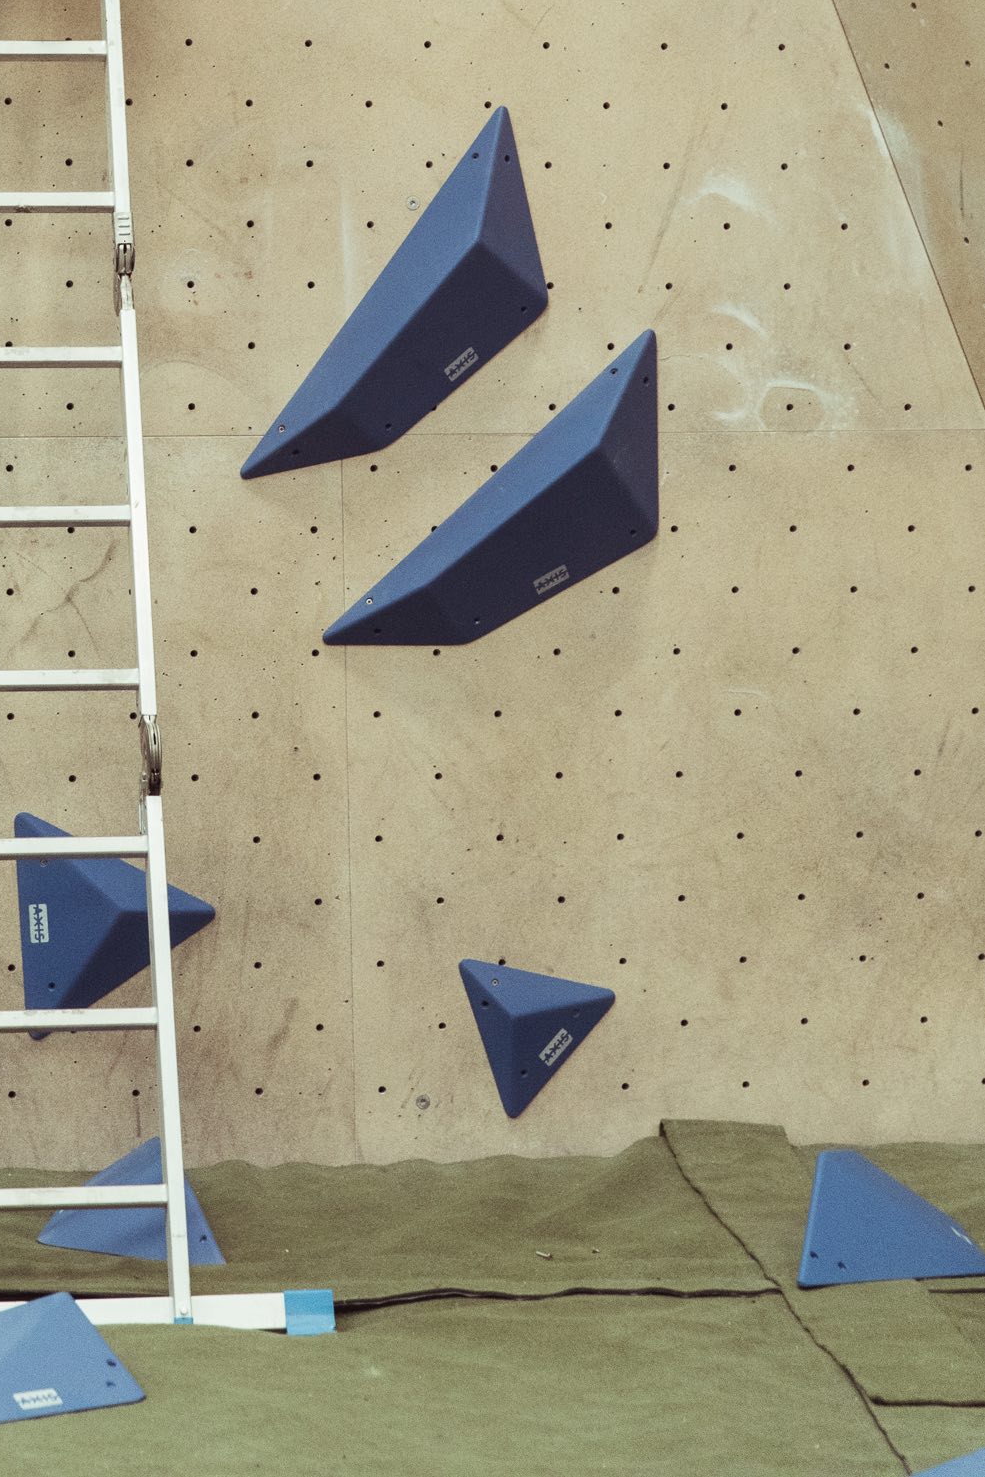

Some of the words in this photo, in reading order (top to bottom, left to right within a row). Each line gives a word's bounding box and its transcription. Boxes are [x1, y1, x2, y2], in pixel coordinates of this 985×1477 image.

[446, 349, 476, 379] AXIS
[535, 567, 568, 591] AXIS
[32, 904, 46, 943] AXIS
[543, 1030, 571, 1064] AXIS
